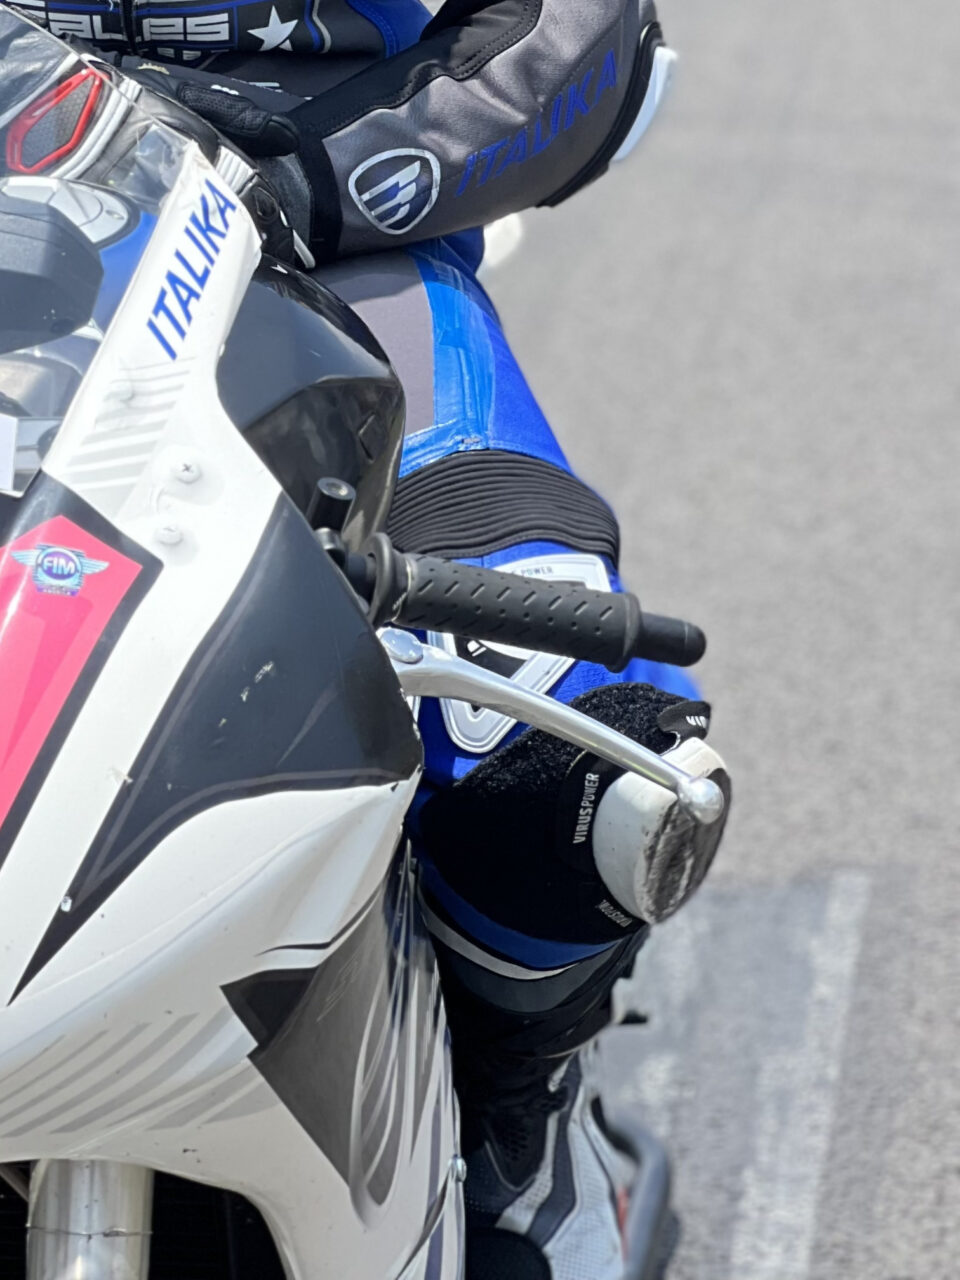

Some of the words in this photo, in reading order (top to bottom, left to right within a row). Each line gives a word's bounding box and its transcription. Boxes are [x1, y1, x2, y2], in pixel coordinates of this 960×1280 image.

[454, 49, 618, 198] ITALIKA
[146, 178, 237, 362] ITALIKA
[43, 556, 76, 576] FIM
